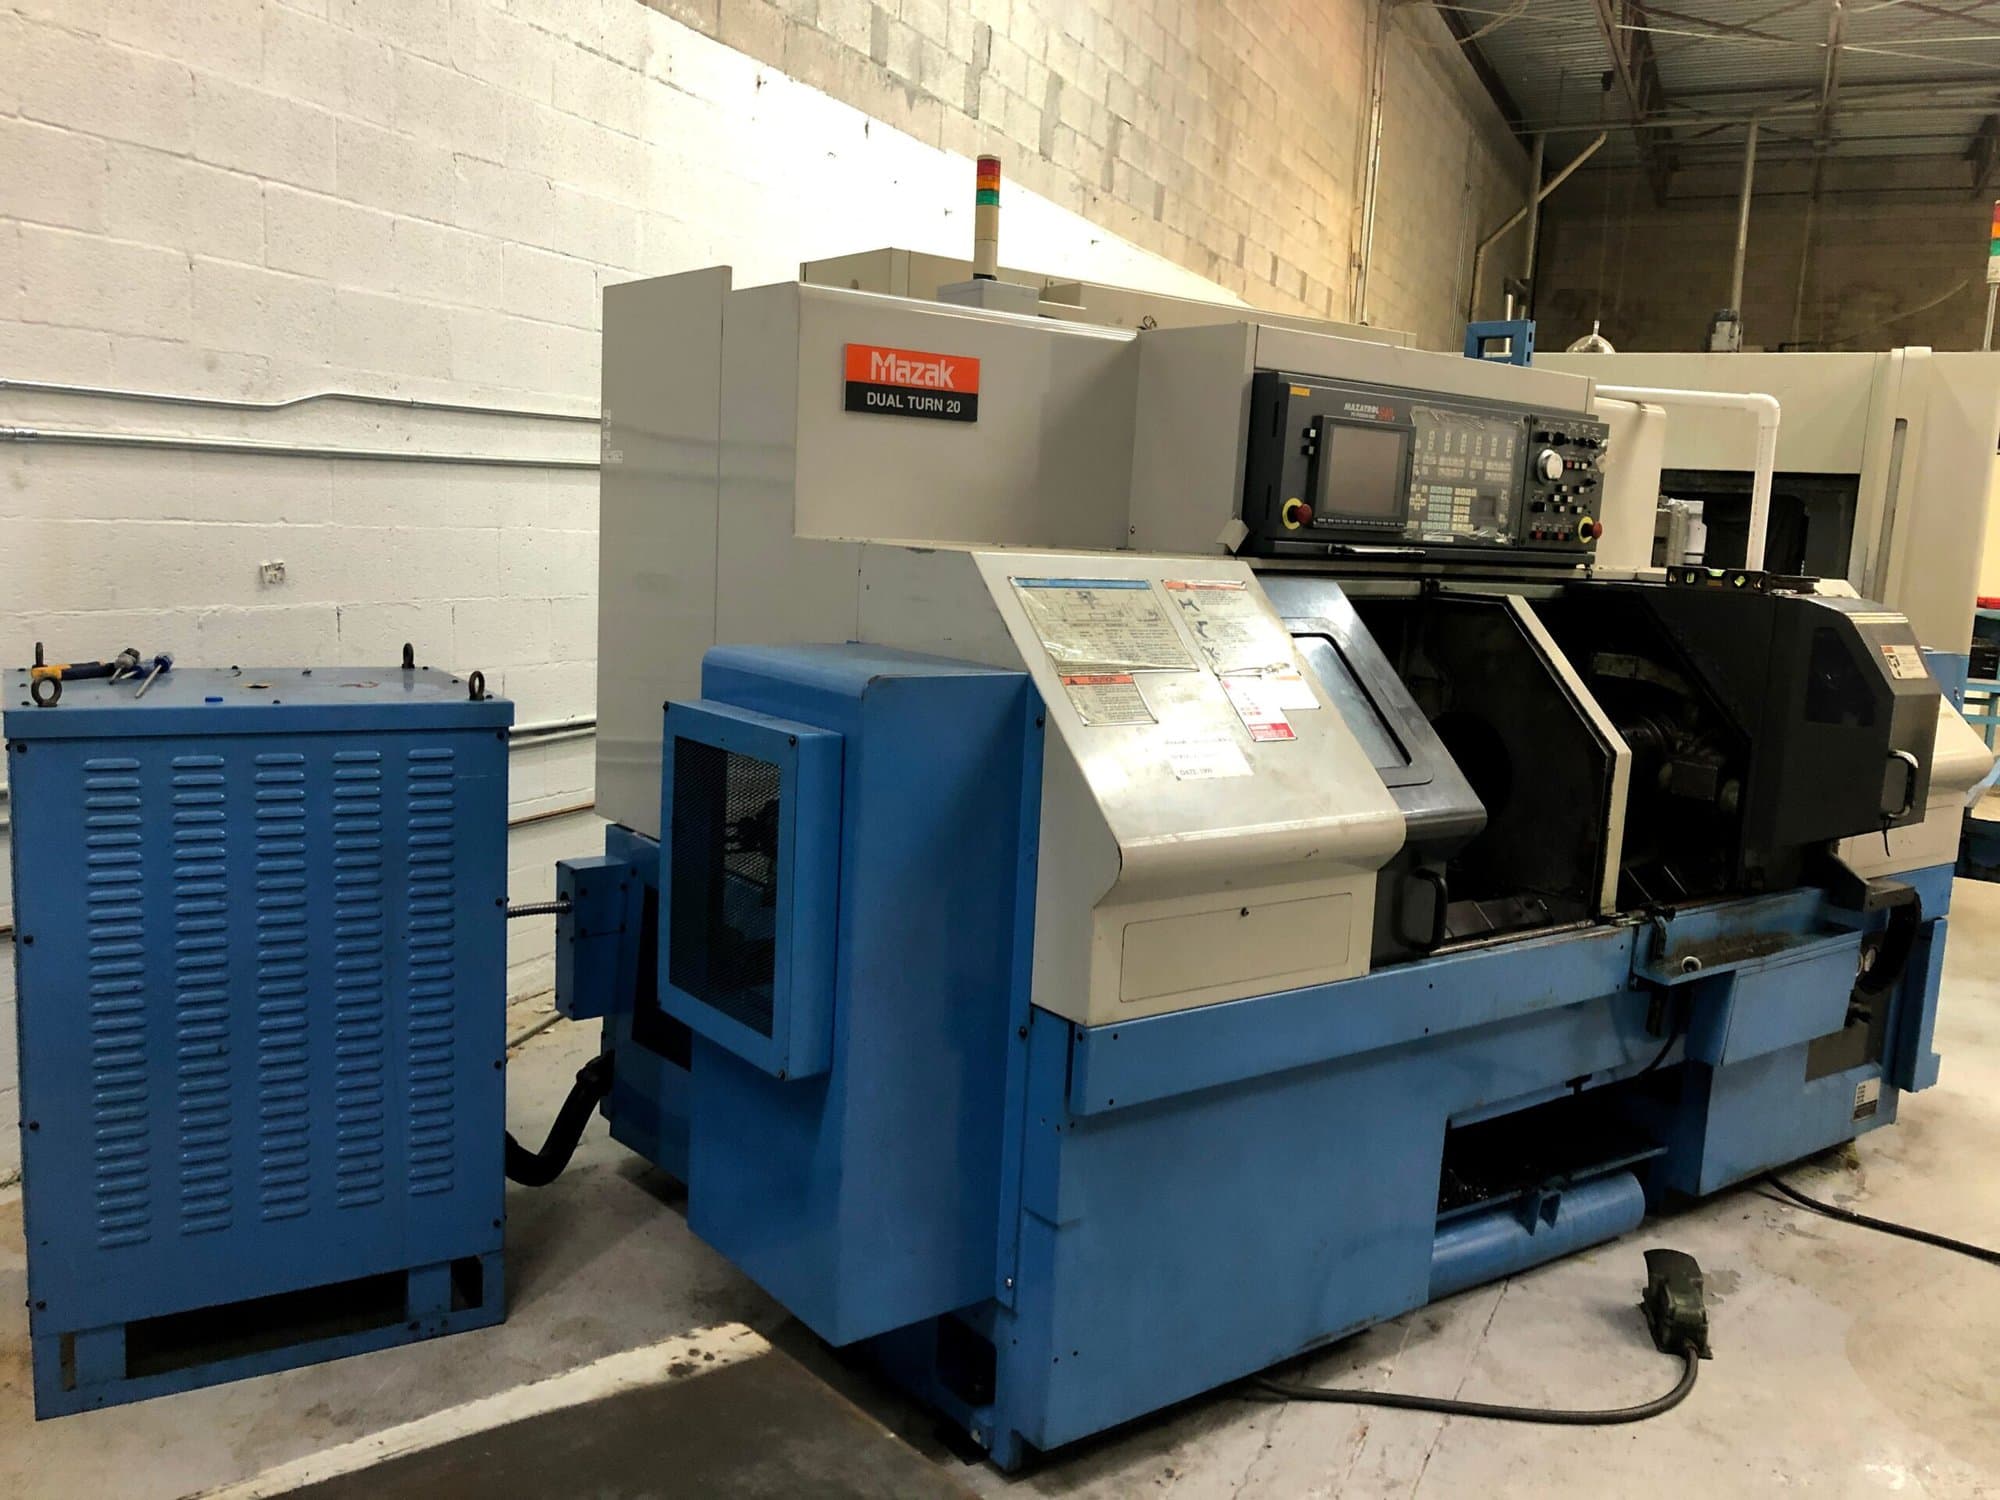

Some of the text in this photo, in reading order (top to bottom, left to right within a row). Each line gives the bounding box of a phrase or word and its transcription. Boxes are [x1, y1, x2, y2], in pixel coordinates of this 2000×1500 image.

[871, 351, 955, 389] Mazak
[866, 391, 961, 414] DUAL TURN 20
